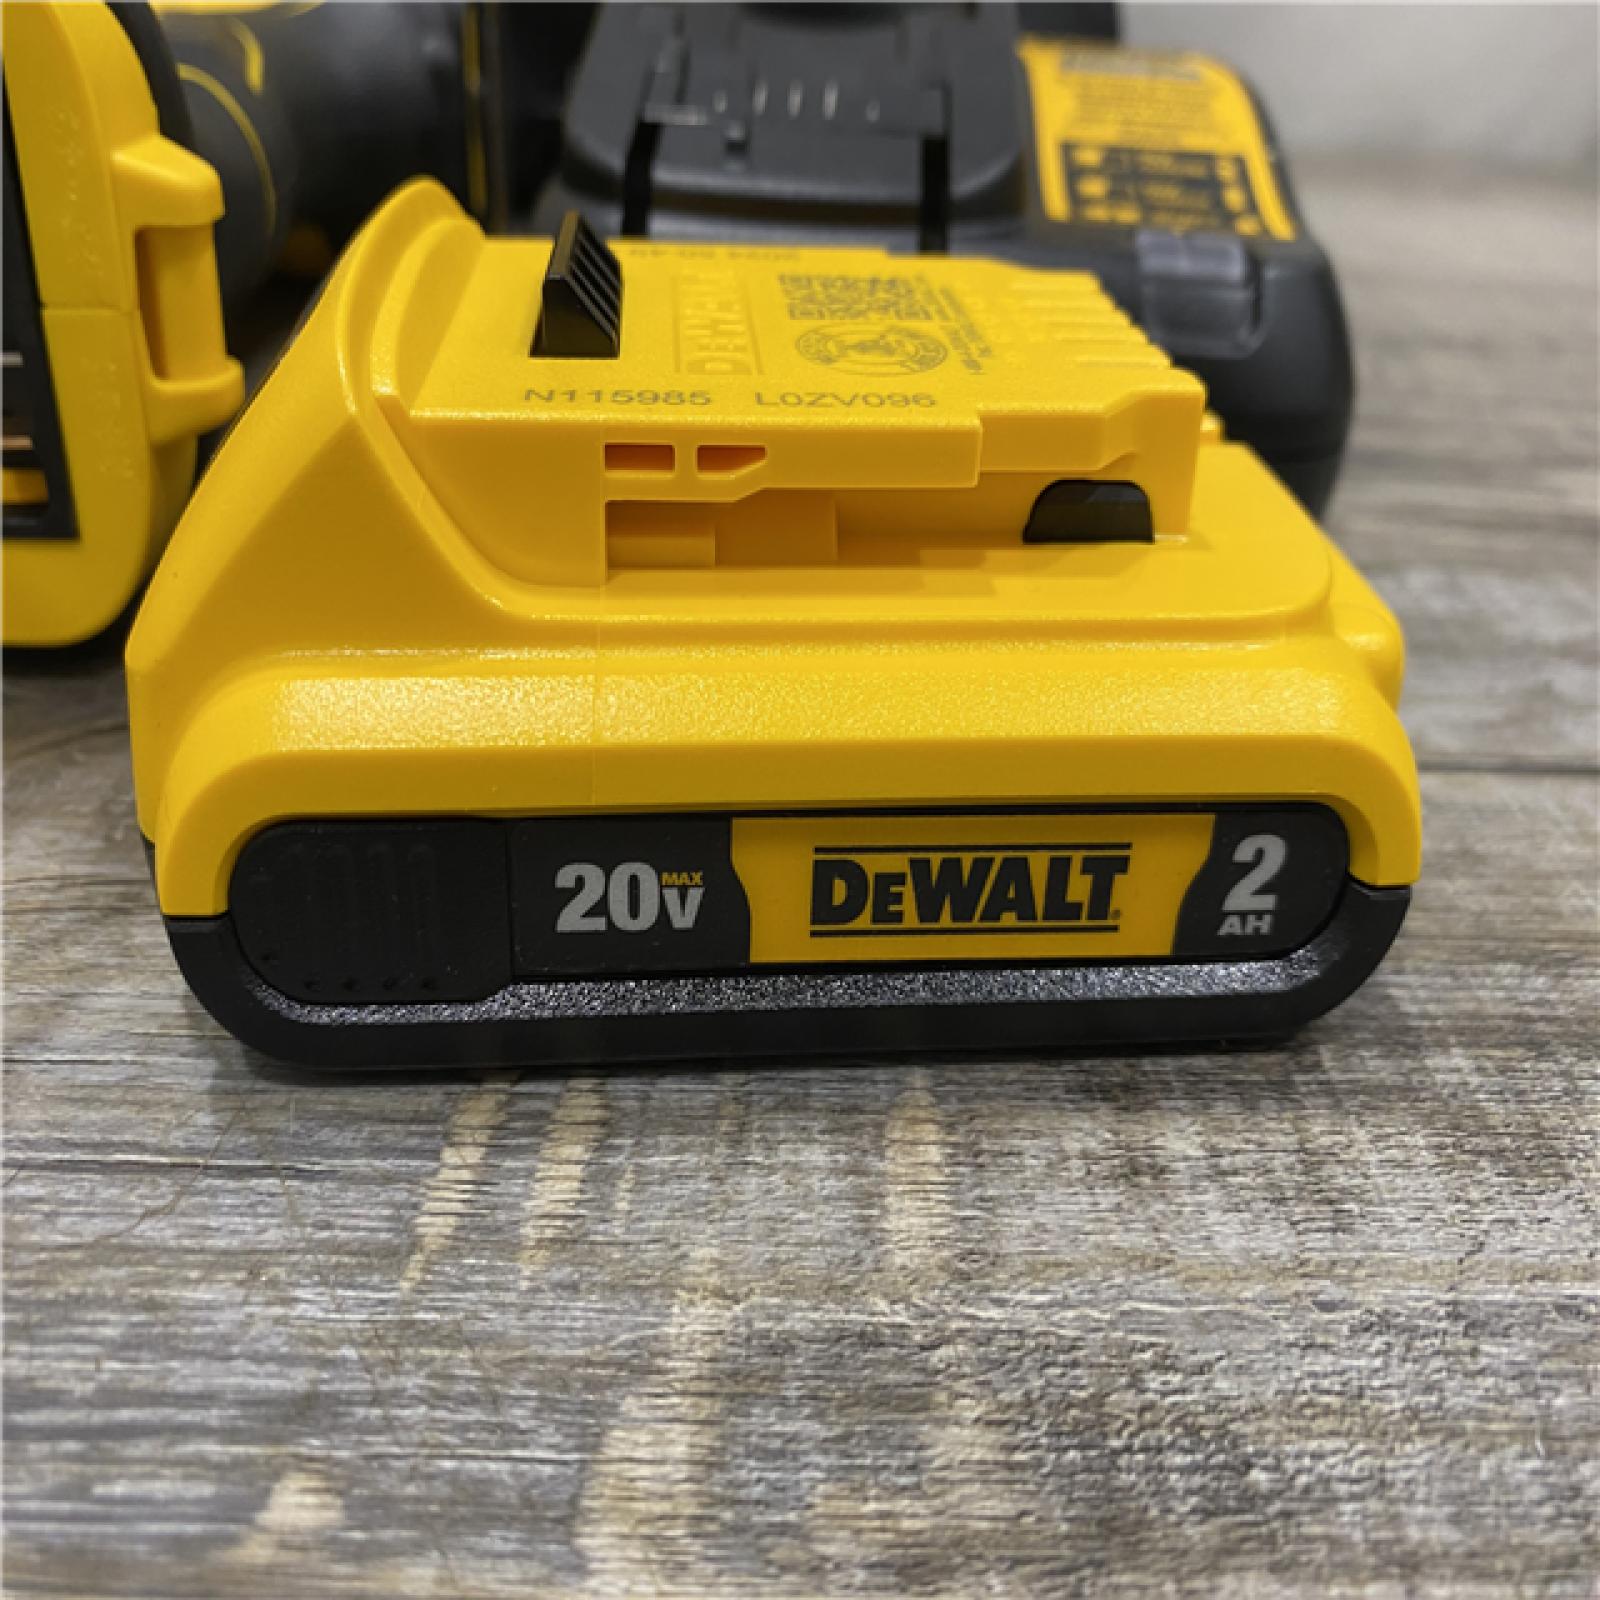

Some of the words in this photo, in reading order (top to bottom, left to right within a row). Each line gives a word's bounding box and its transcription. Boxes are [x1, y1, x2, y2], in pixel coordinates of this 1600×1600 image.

[661, 872, 704, 886] MAX
[1222, 834, 1286, 911] 2
[1217, 914, 1272, 936] AH
